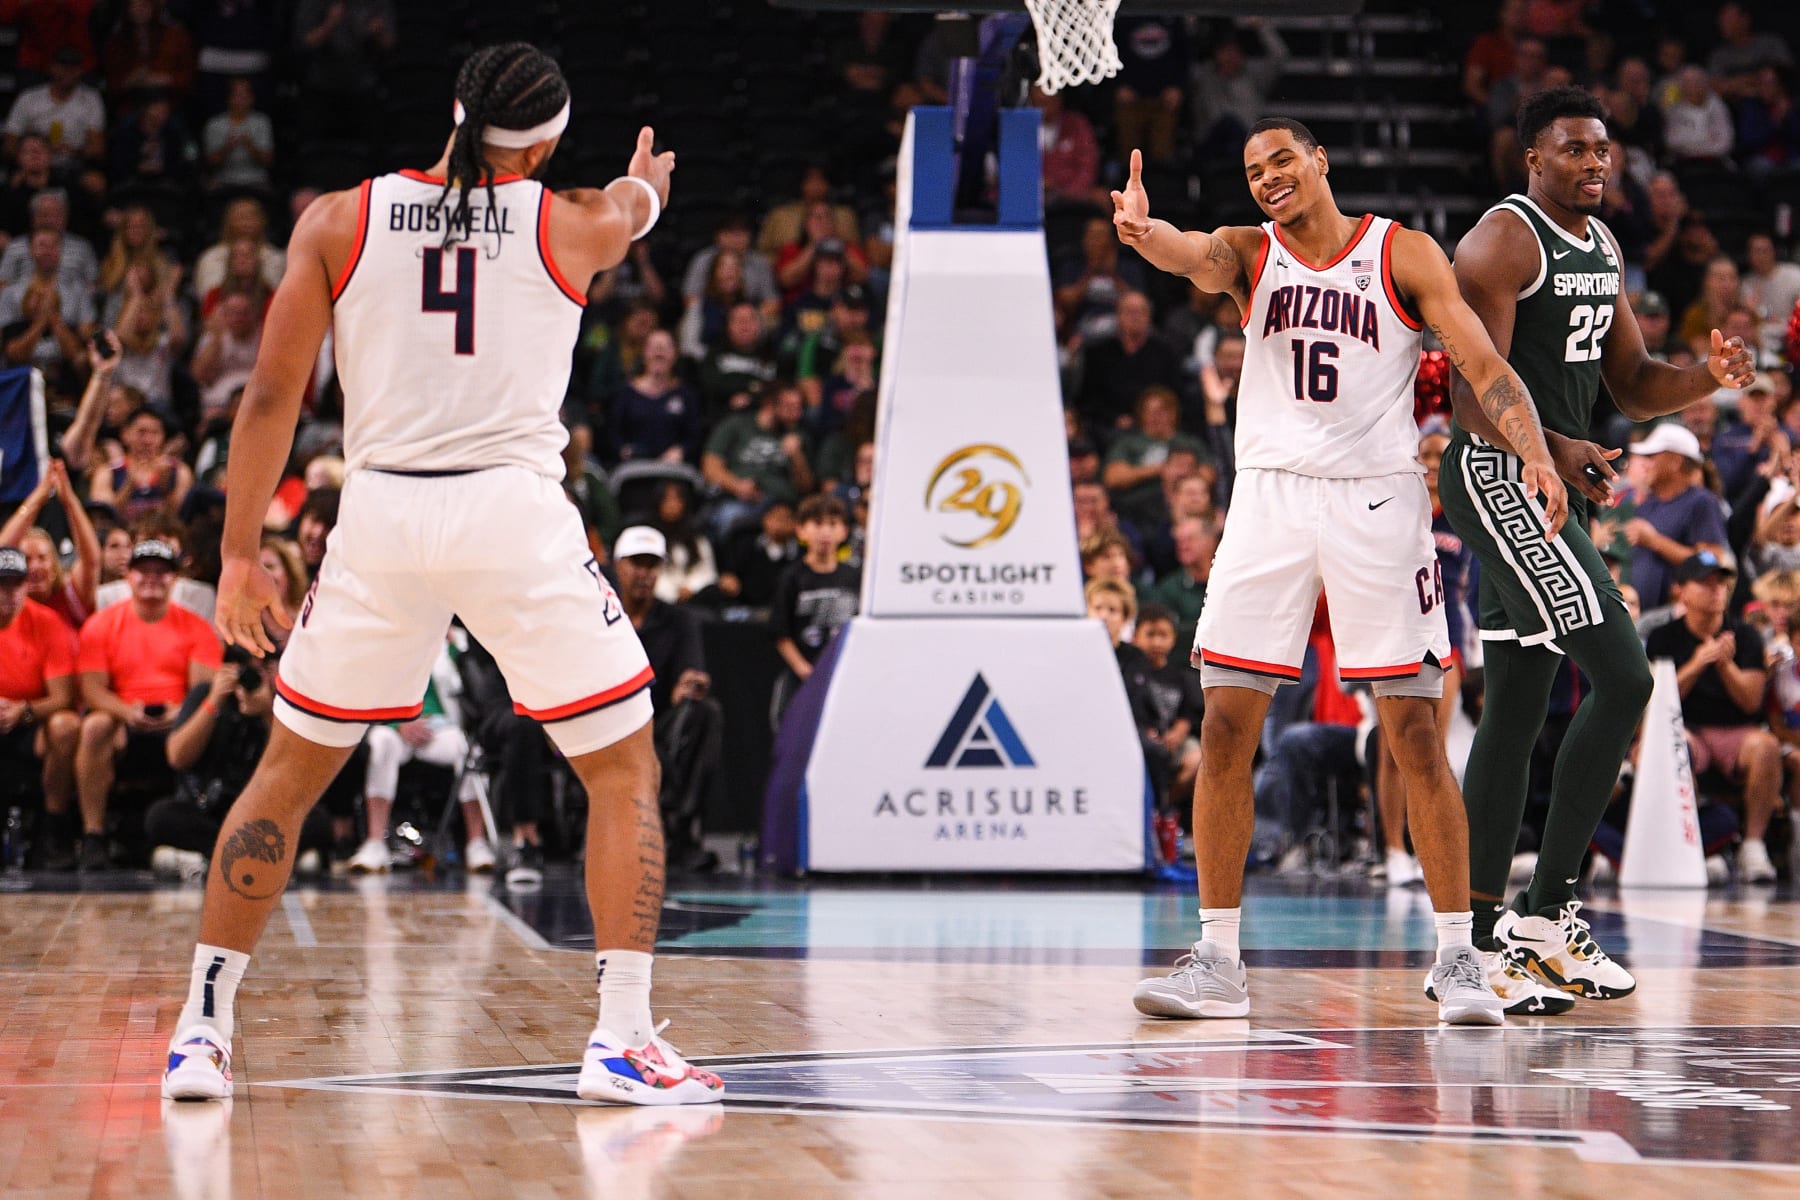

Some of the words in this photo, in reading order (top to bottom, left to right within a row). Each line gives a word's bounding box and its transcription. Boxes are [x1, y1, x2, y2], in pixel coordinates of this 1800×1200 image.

[421, 246, 478, 356] 4
[1553, 272, 1620, 296] SPARTANS
[1262, 284, 1380, 353] ARIZONA
[1564, 304, 1614, 363] 22
[1290, 338, 1340, 403] 16
[938, 466, 1023, 549] 29
[900, 562, 1056, 585] SPOTLIGHT
[932, 588, 1025, 605] CASINO
[874, 787, 1090, 817] ACRISURE
[935, 821, 1027, 841] ARENA
